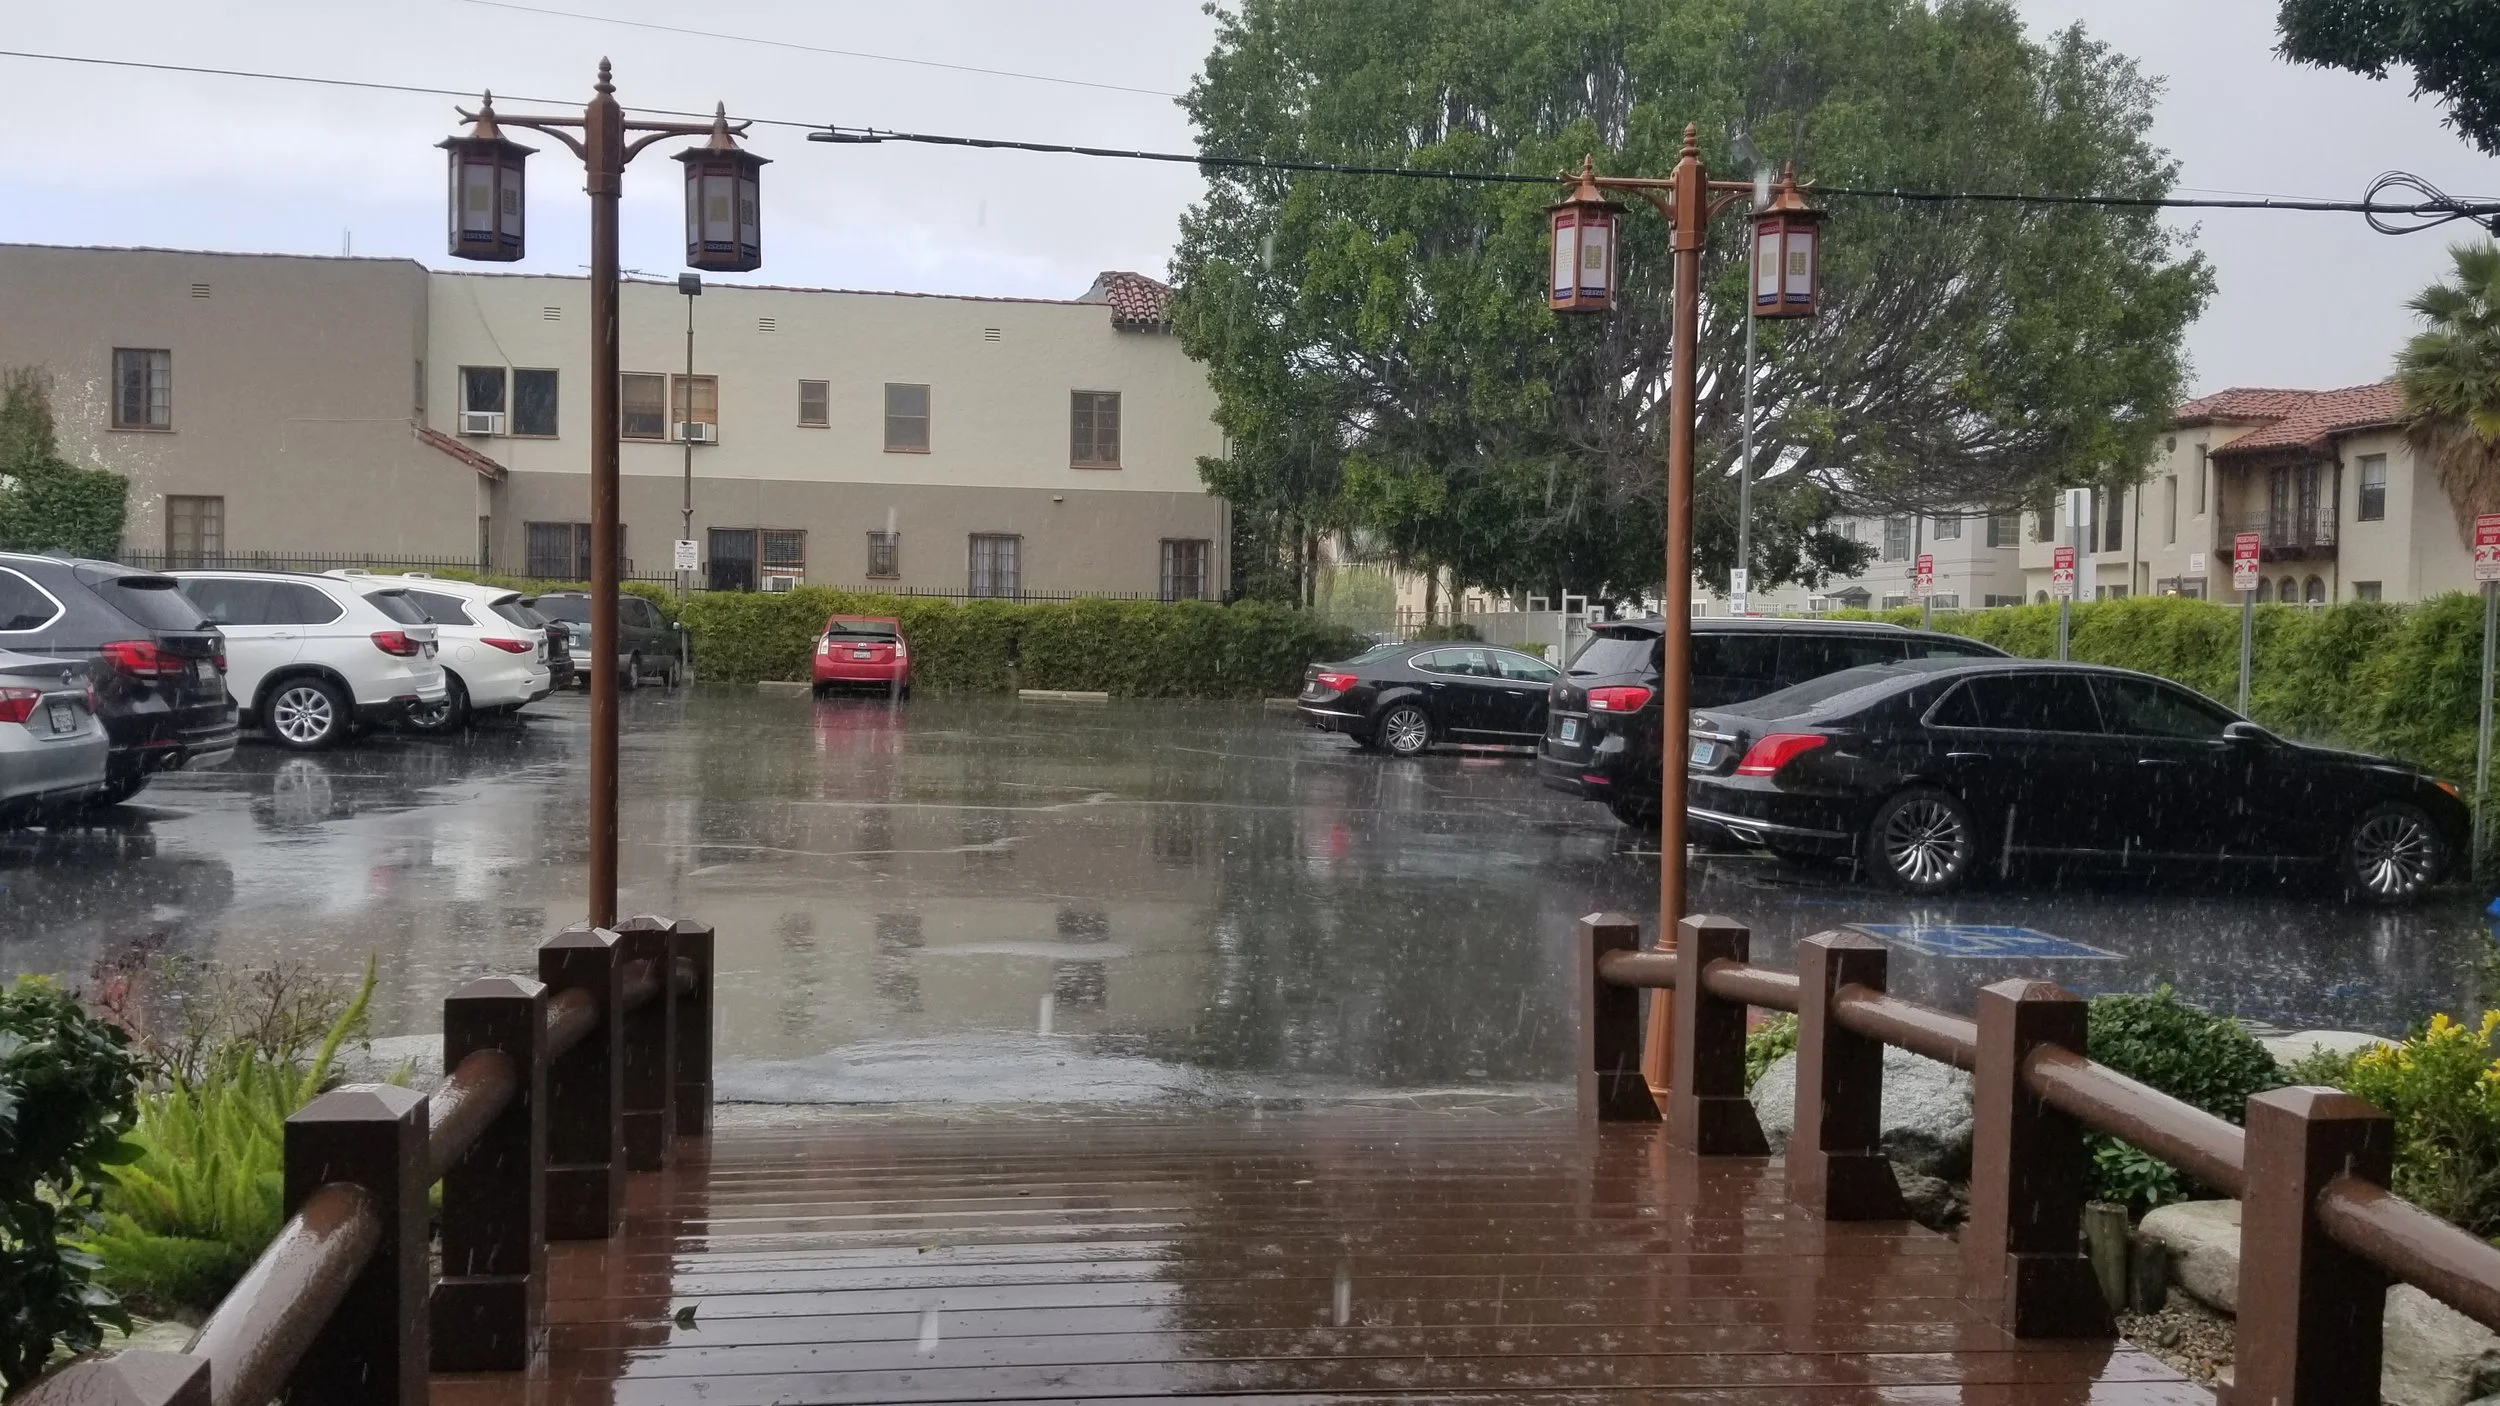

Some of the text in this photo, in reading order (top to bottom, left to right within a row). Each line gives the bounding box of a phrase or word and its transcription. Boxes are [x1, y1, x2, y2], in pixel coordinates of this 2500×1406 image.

[2478, 517, 2500, 526] RESERVE
[2236, 536, 2258, 544] RESERVED
[2483, 536, 2498, 544] ONLY
